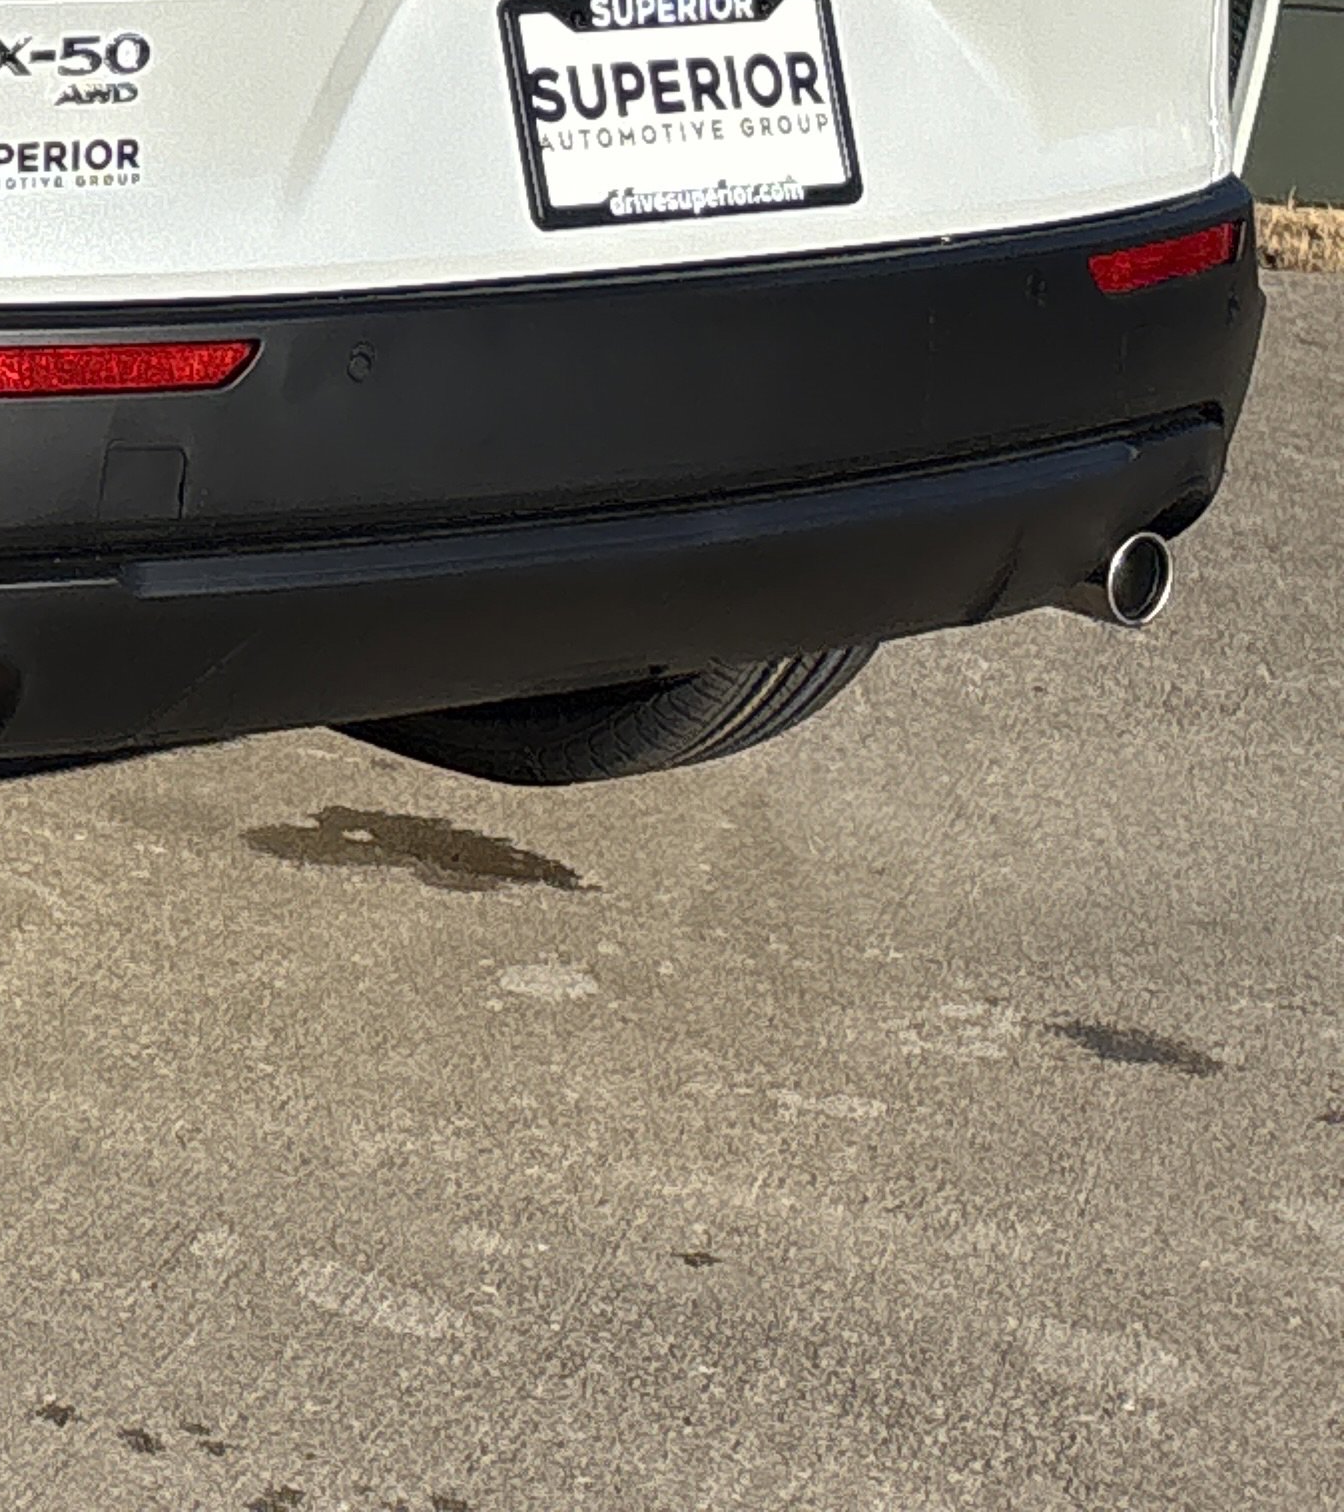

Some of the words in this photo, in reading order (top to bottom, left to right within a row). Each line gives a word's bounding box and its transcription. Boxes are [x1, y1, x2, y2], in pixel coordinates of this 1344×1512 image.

[54, 82, 139, 106] AWD
[529, 51, 826, 123] SUPERIOR
[540, 119, 724, 152] AUTOMOTIVE
[740, 113, 828, 137] GROUP
[75, 174, 140, 188] GROUP
[610, 181, 805, 216] drivesuperior.com
